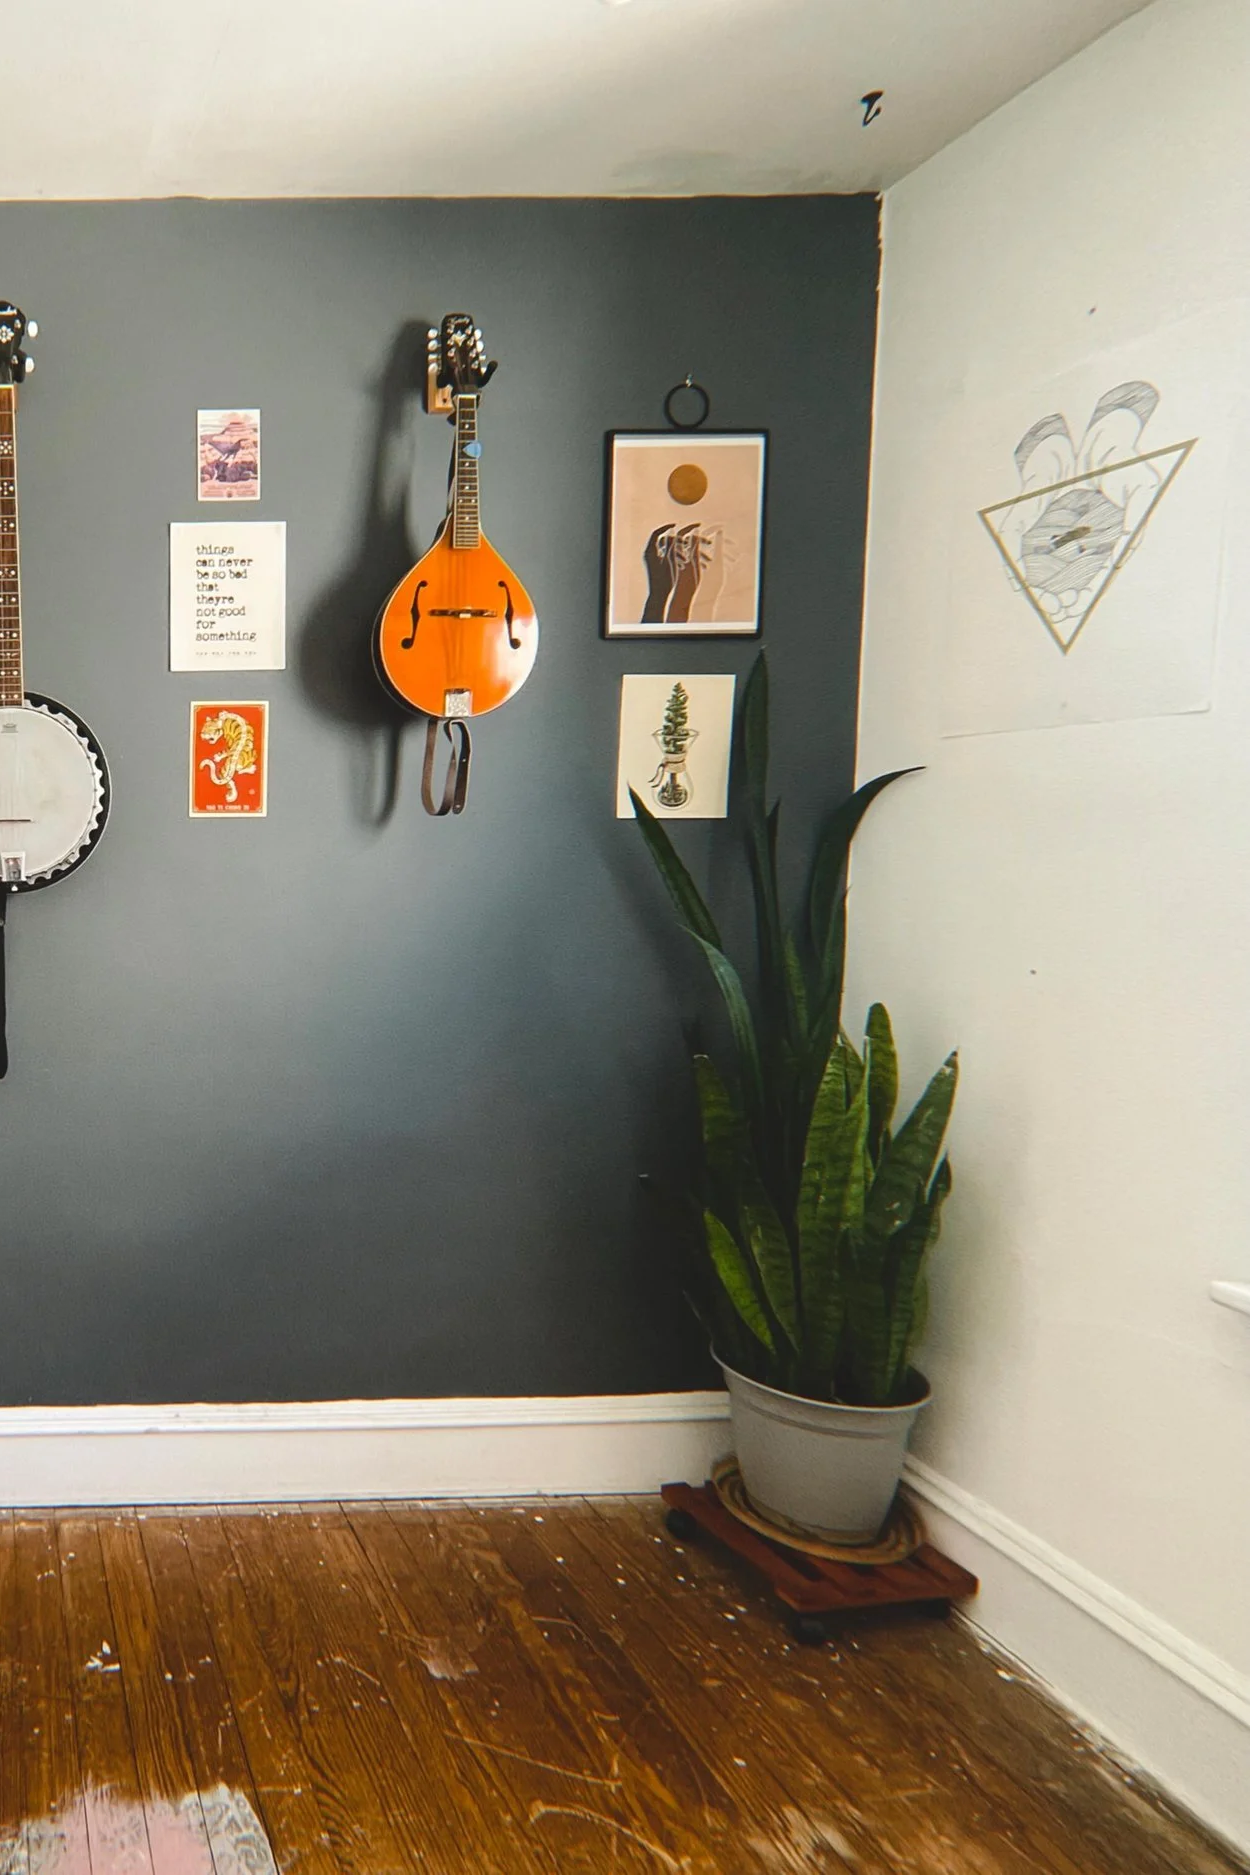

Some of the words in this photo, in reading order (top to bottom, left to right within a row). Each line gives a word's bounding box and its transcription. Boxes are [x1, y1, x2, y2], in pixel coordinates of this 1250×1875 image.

[196, 544, 235, 556] things
[196, 559, 215, 567] can
[219, 558, 253, 567] never
[196, 569, 209, 580] be
[212, 571, 226, 580] so
[229, 568, 247, 579] bad
[196, 582, 219, 592] that
[196, 607, 216, 617] not
[218, 605, 246, 619] good
[196, 620, 216, 629] for
[196, 630, 257, 642] something
